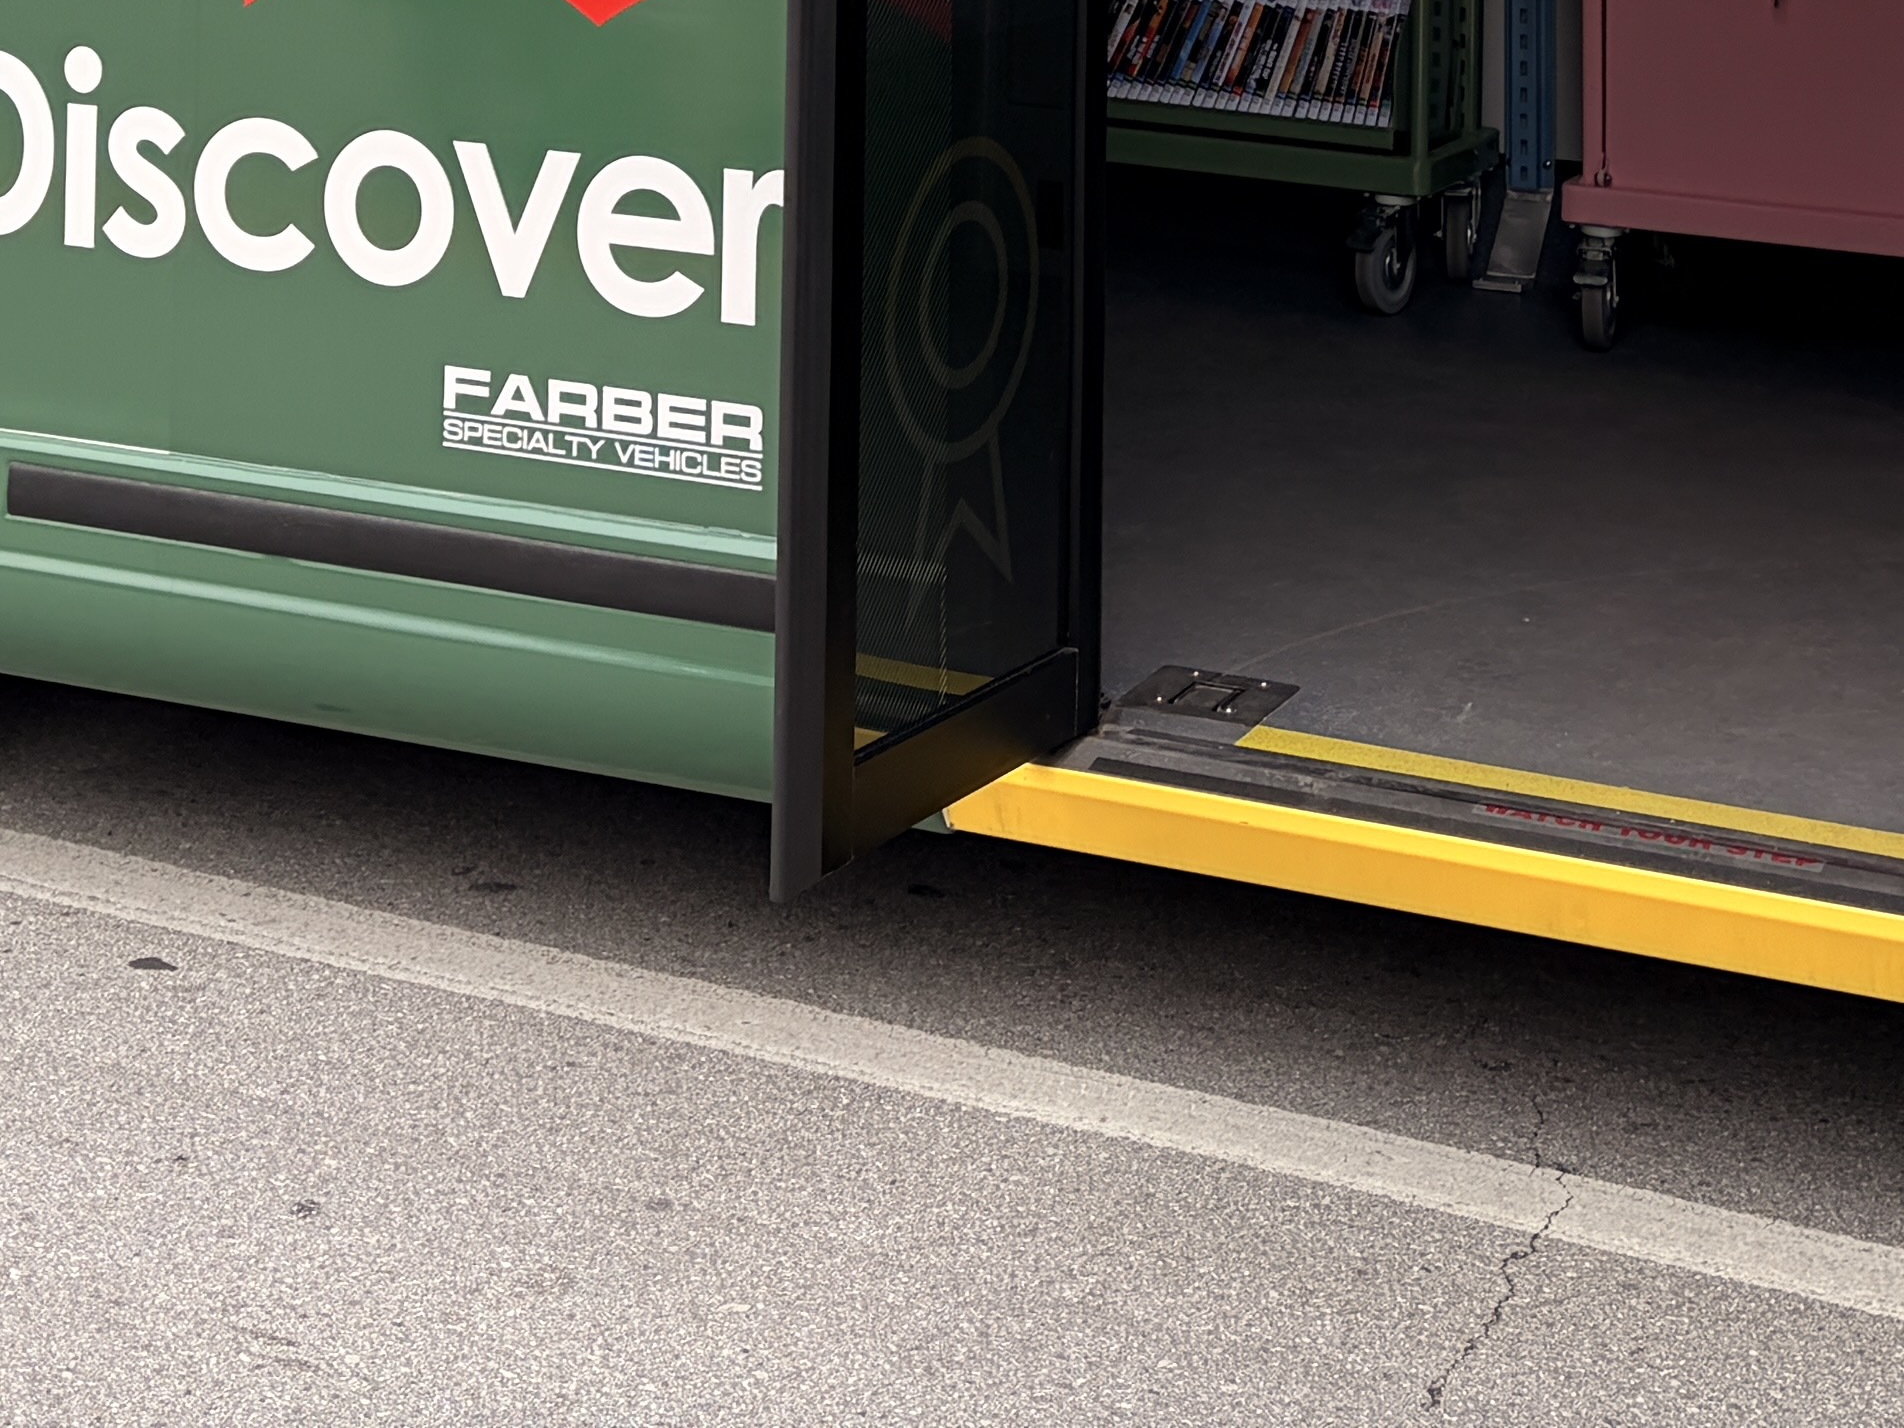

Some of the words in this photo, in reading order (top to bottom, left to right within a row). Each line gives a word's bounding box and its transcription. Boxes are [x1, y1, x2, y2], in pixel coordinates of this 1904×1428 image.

[443, 364, 764, 451] FARBER
[442, 417, 606, 460] SPECIALTY
[614, 441, 763, 483] VEHICLES
